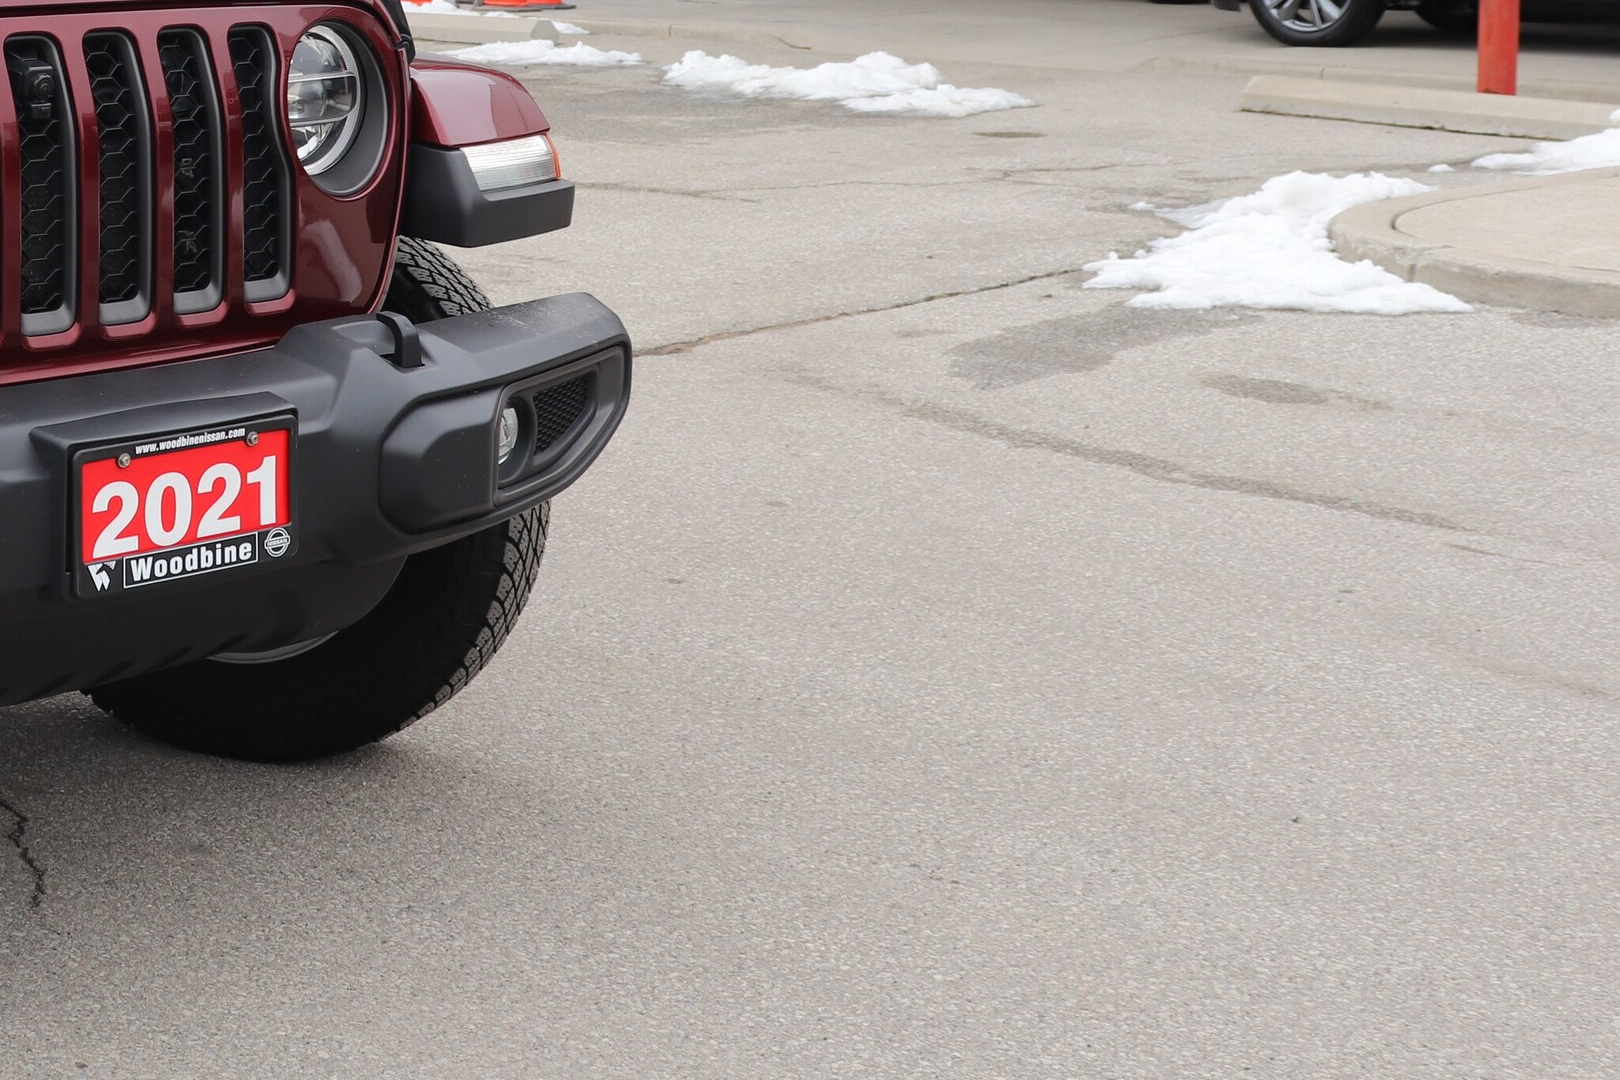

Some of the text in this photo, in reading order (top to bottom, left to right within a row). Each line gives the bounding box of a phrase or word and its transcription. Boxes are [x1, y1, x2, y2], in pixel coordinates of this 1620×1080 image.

[135, 427, 246, 455] www.woodbinenissan.com
[91, 455, 277, 559] 2021
[266, 537, 288, 547] NISSAN
[130, 540, 253, 582] Woodbine
